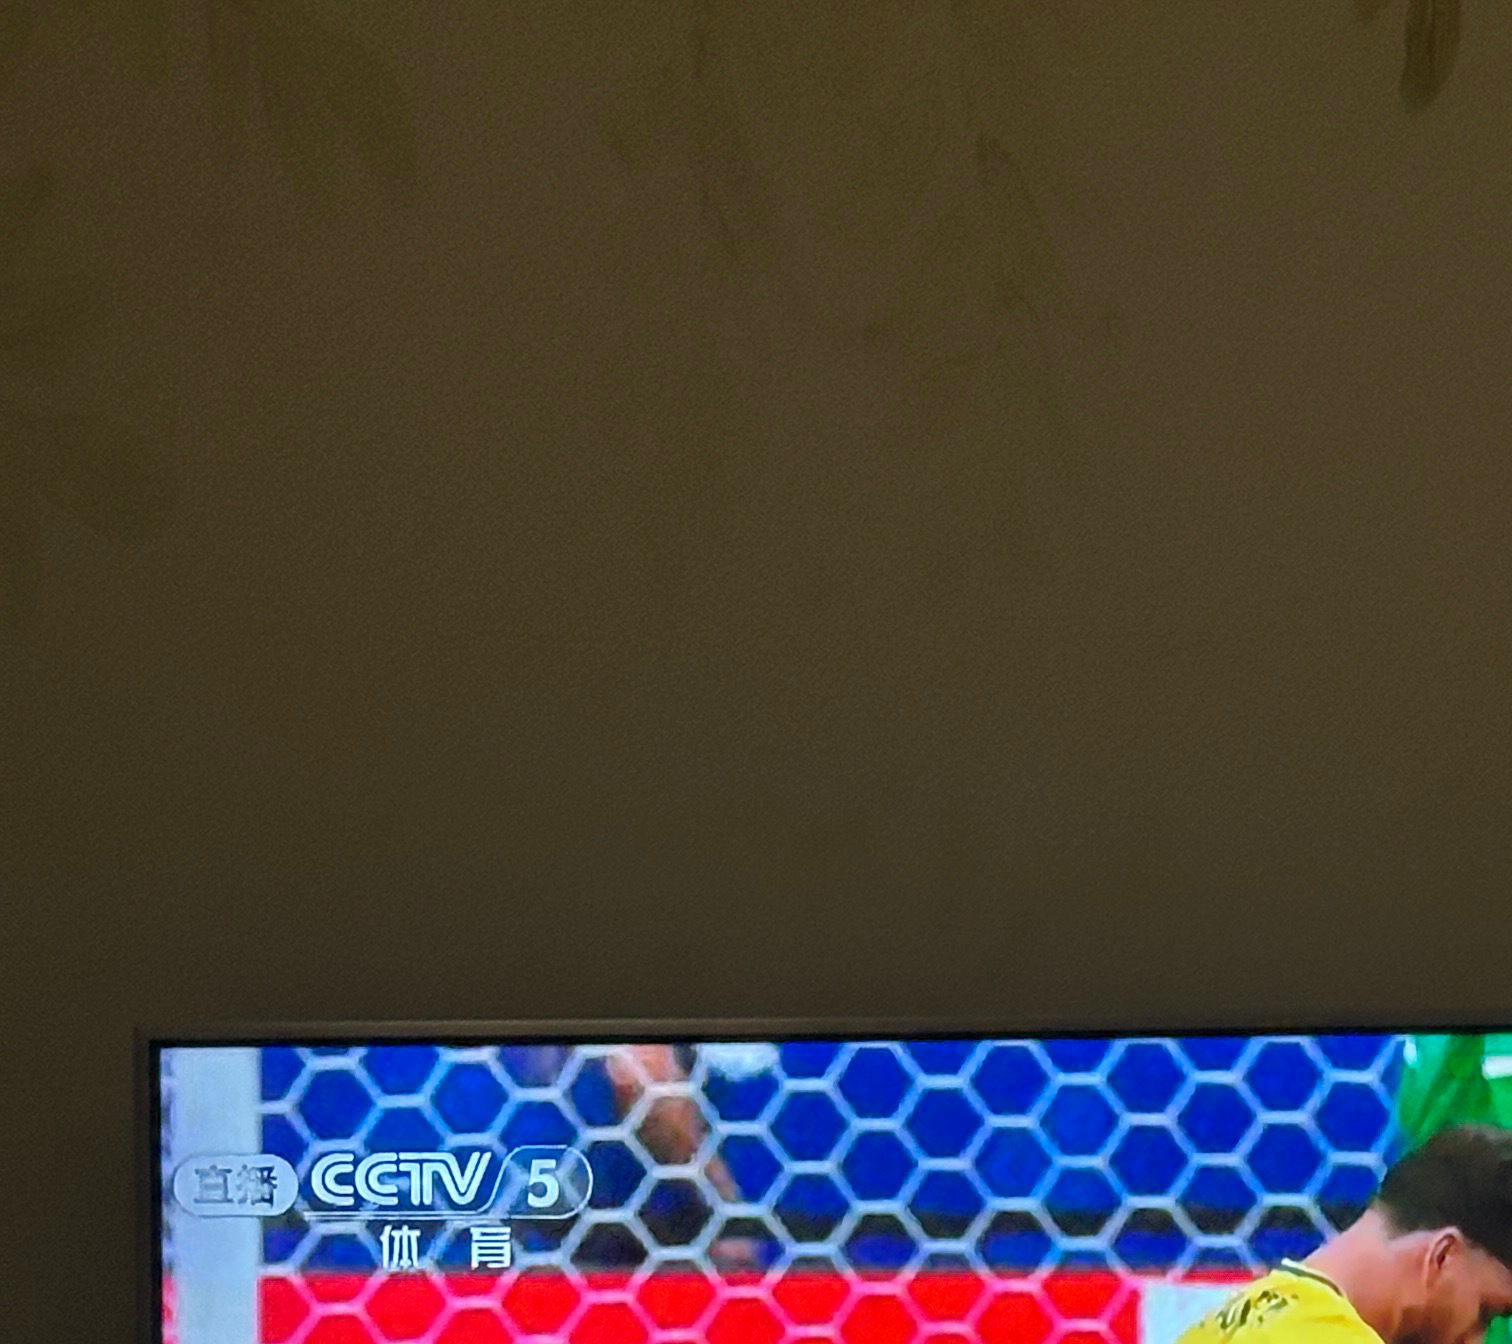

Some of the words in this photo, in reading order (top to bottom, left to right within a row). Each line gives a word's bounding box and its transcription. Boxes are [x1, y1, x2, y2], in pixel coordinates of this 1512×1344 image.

[193, 1164, 278, 1208] 直播
[310, 1151, 492, 1207] CCTV
[527, 1158, 560, 1209] 5
[379, 1224, 513, 1270] 体育
